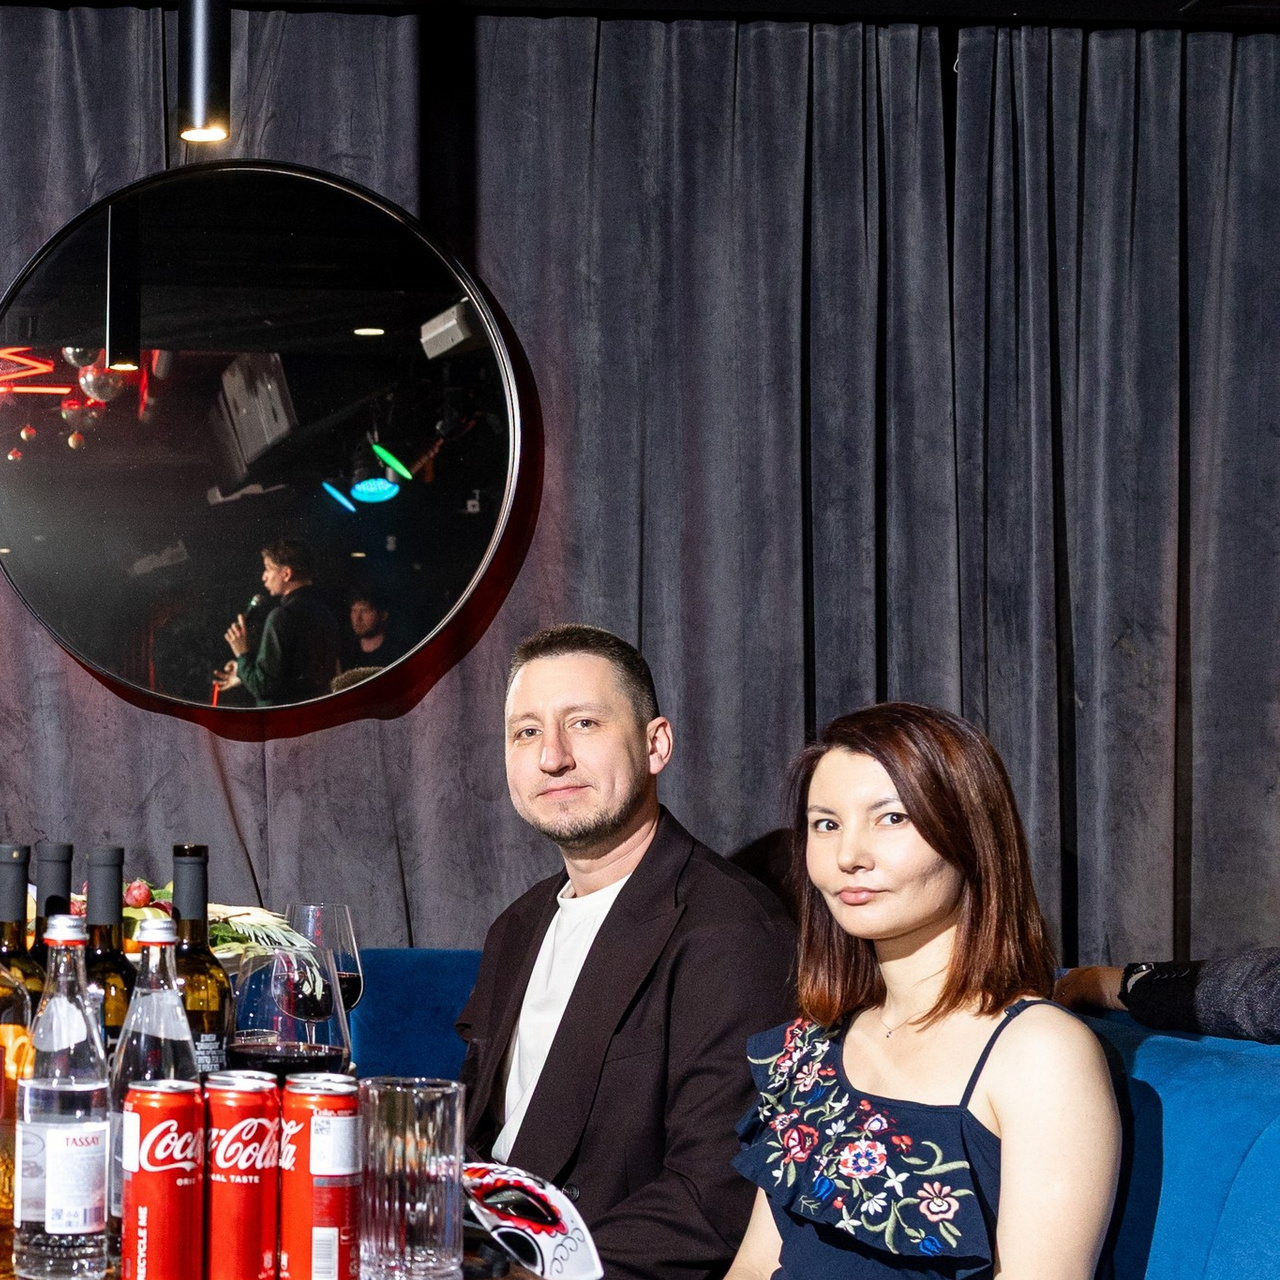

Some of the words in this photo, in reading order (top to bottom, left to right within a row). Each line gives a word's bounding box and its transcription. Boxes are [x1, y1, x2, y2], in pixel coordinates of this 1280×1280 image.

[65, 1135, 100, 1148] TASSAY
[229, 1174, 260, 1184] TASTE
[137, 1206, 148, 1227] ME
